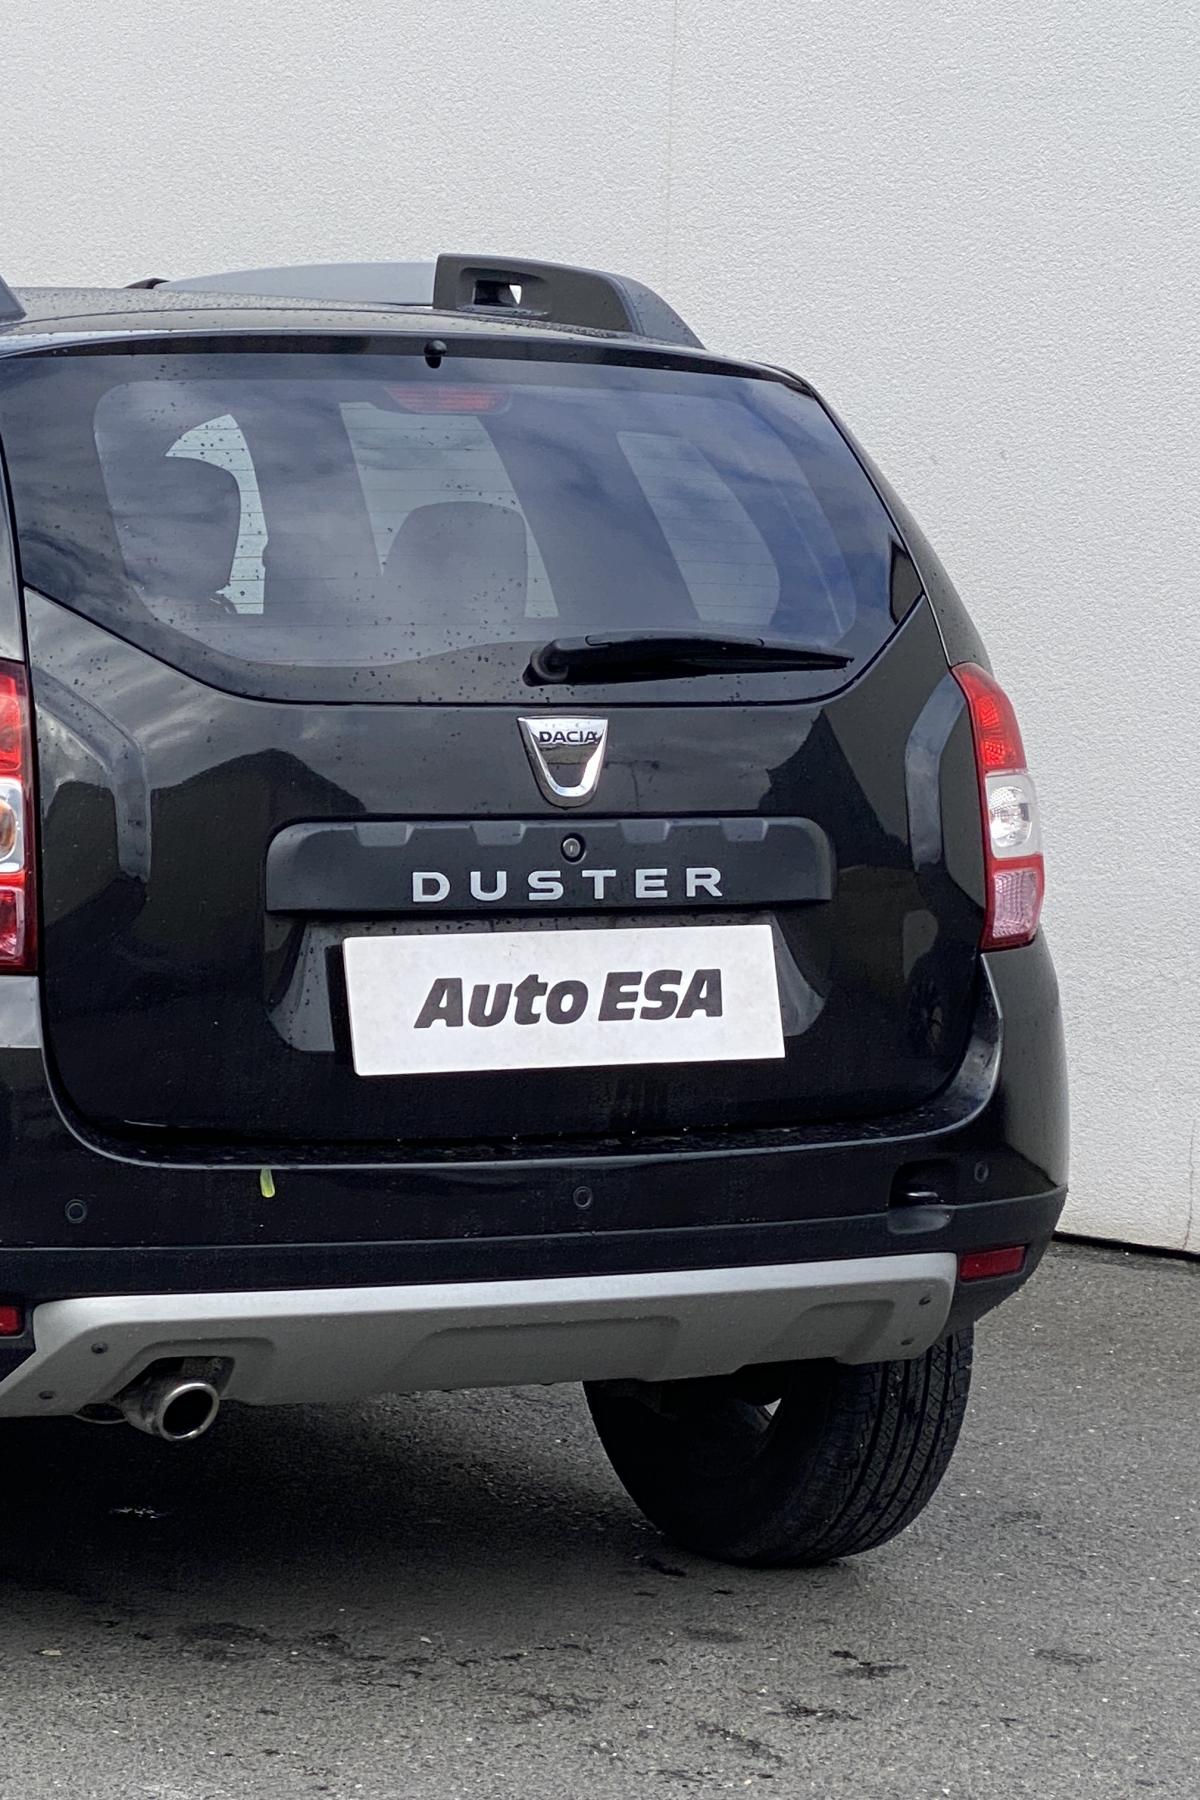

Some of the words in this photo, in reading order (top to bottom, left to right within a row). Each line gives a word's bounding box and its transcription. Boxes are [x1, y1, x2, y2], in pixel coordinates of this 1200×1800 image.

[539, 731, 598, 742] DACIA
[412, 867, 723, 902] DUSTER
[414, 974, 588, 1028] Auto
[598, 969, 723, 1020] ESA
